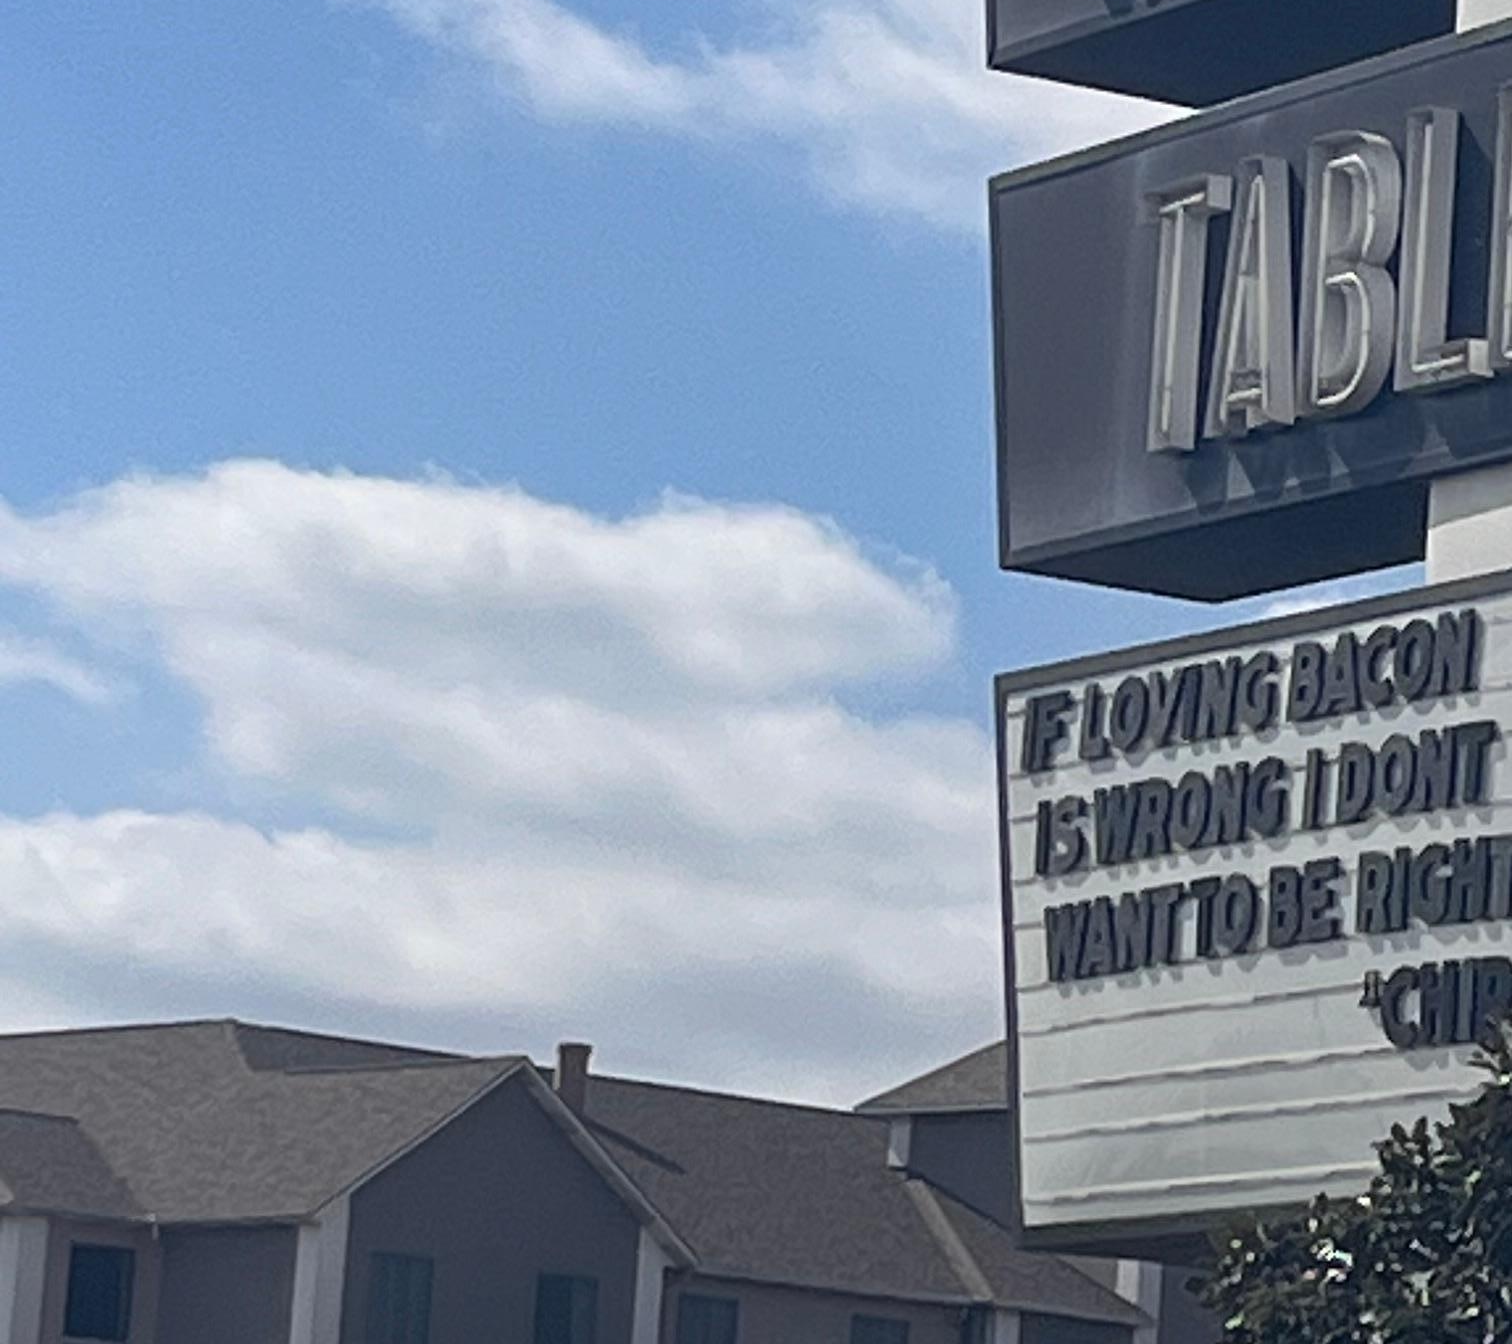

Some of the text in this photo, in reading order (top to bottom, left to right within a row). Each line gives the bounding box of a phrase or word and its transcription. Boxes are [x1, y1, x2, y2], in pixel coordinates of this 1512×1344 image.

[1021, 609, 1482, 773] IF LOVING BACON
[1034, 720, 1498, 877] IS WRONG I DONT
[1044, 881, 1186, 984] WANT
[1190, 872, 1262, 958] TO
[1268, 857, 1342, 950] BE
